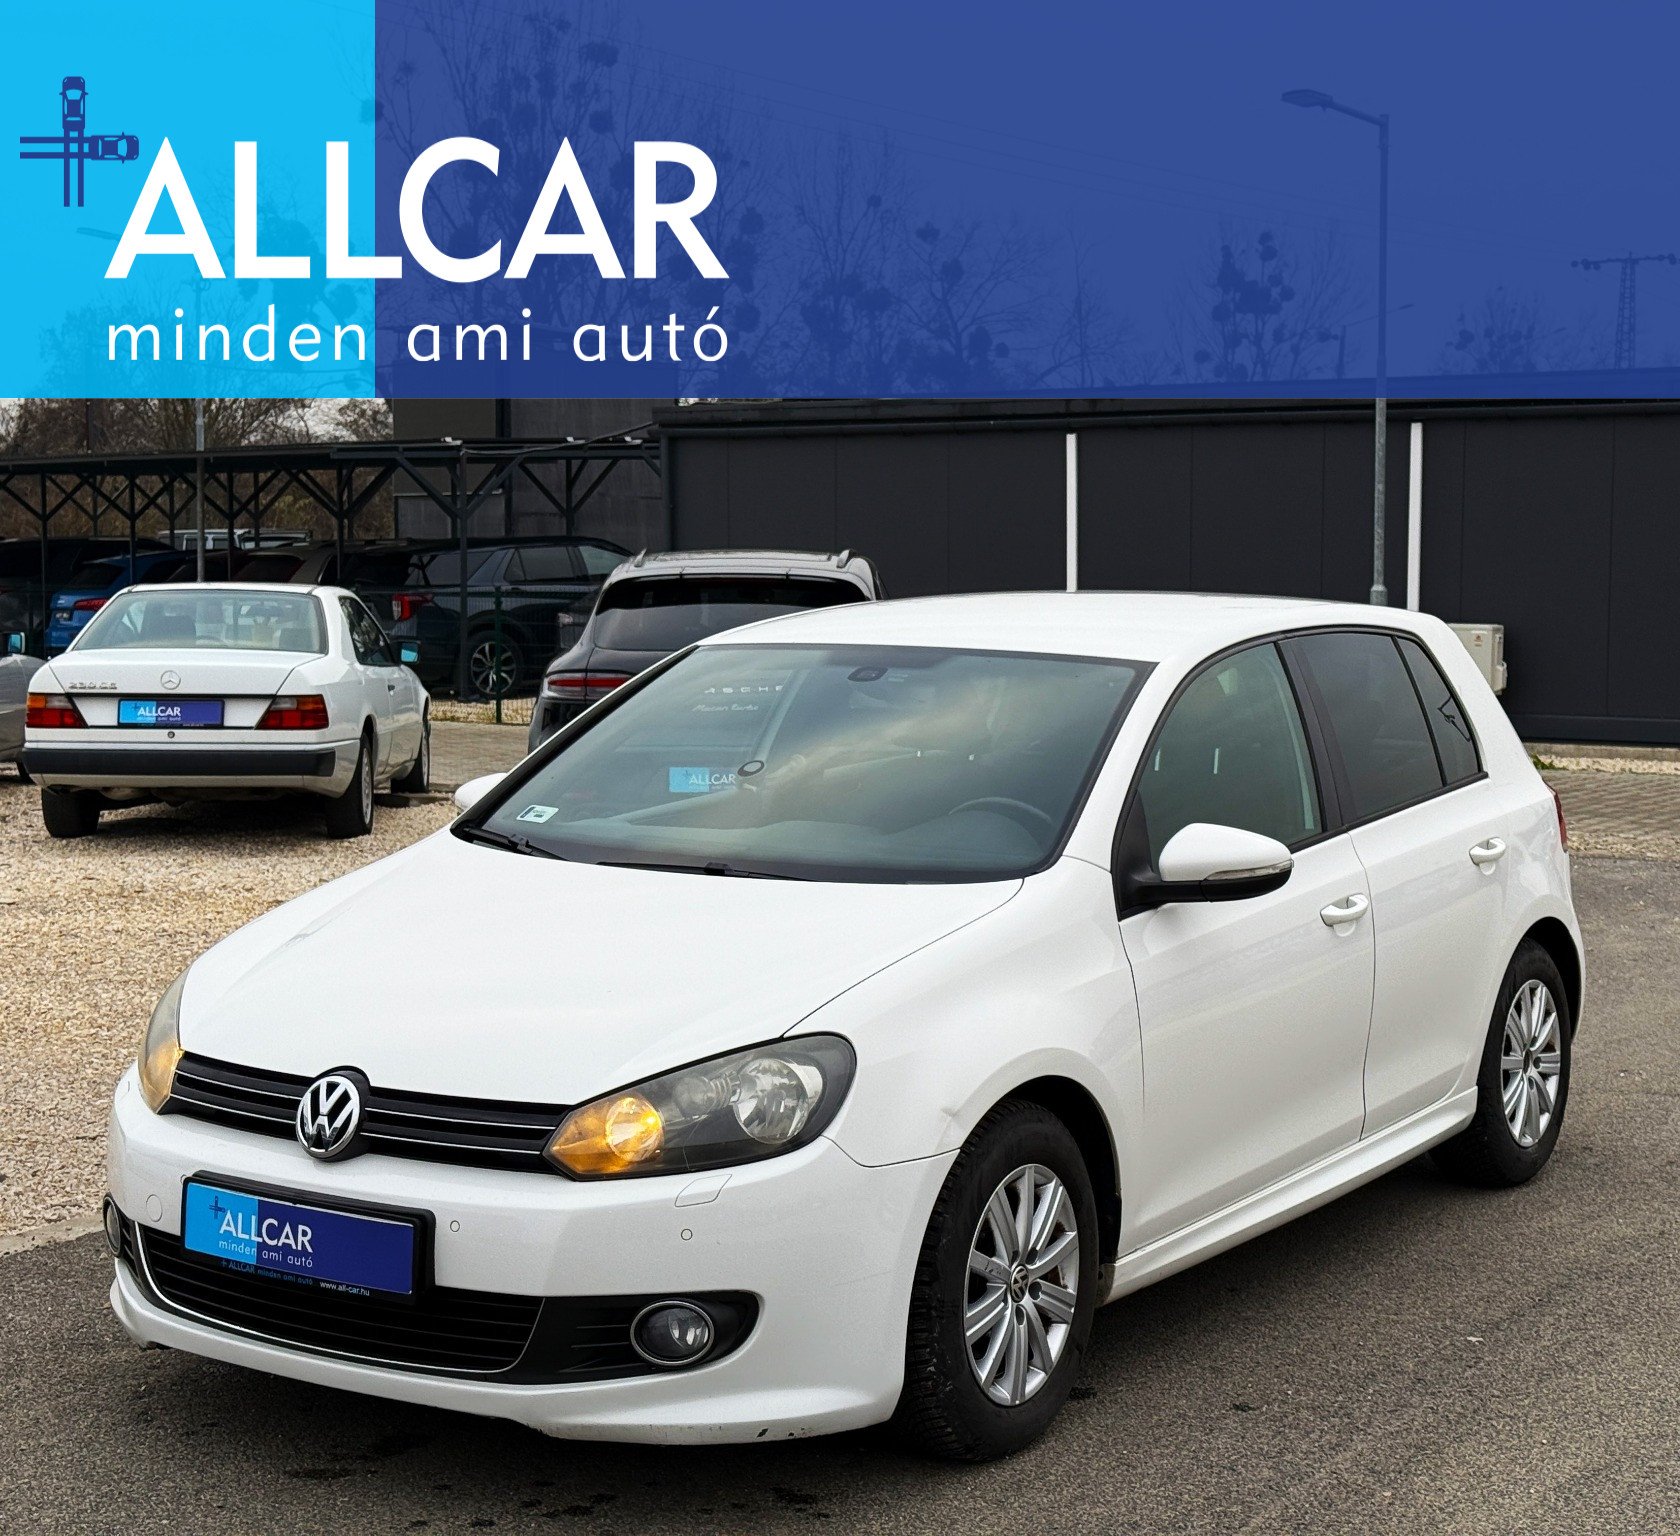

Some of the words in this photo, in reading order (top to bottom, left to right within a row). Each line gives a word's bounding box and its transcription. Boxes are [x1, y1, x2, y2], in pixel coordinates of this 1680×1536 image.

[137, 706, 181, 717] ALLCAR
[689, 773, 737, 785] ALLCAR
[219, 1210, 313, 1253] ALLCAR
[218, 1239, 257, 1255] minden
[262, 1249, 282, 1262] ami
[287, 1253, 313, 1268] autó
[228, 1260, 255, 1274] ALLCAR
[319, 1280, 370, 1296] www.all-car.hu
